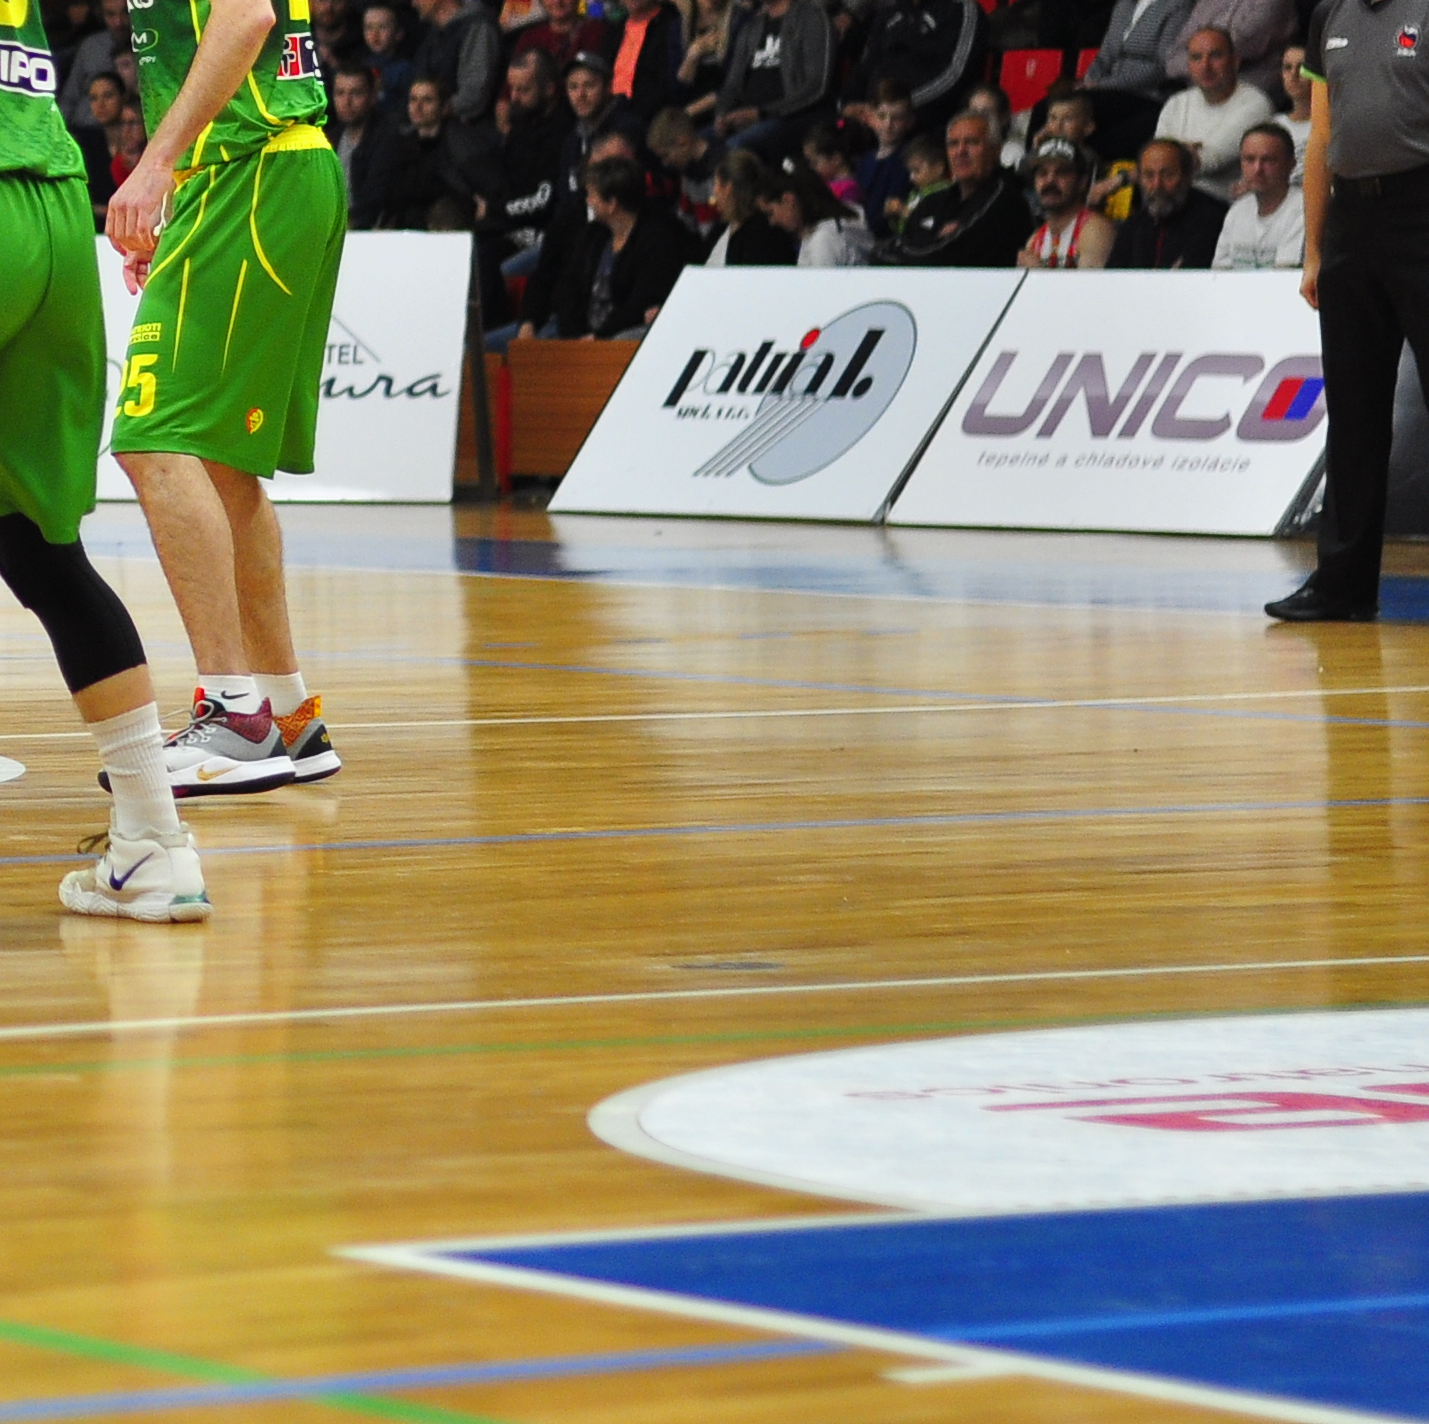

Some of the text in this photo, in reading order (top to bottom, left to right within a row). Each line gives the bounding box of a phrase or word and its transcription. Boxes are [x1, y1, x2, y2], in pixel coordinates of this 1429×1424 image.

[114, 353, 159, 419] 5
[962, 351, 1327, 443] UNICO
[1055, 456, 1067, 466] a
